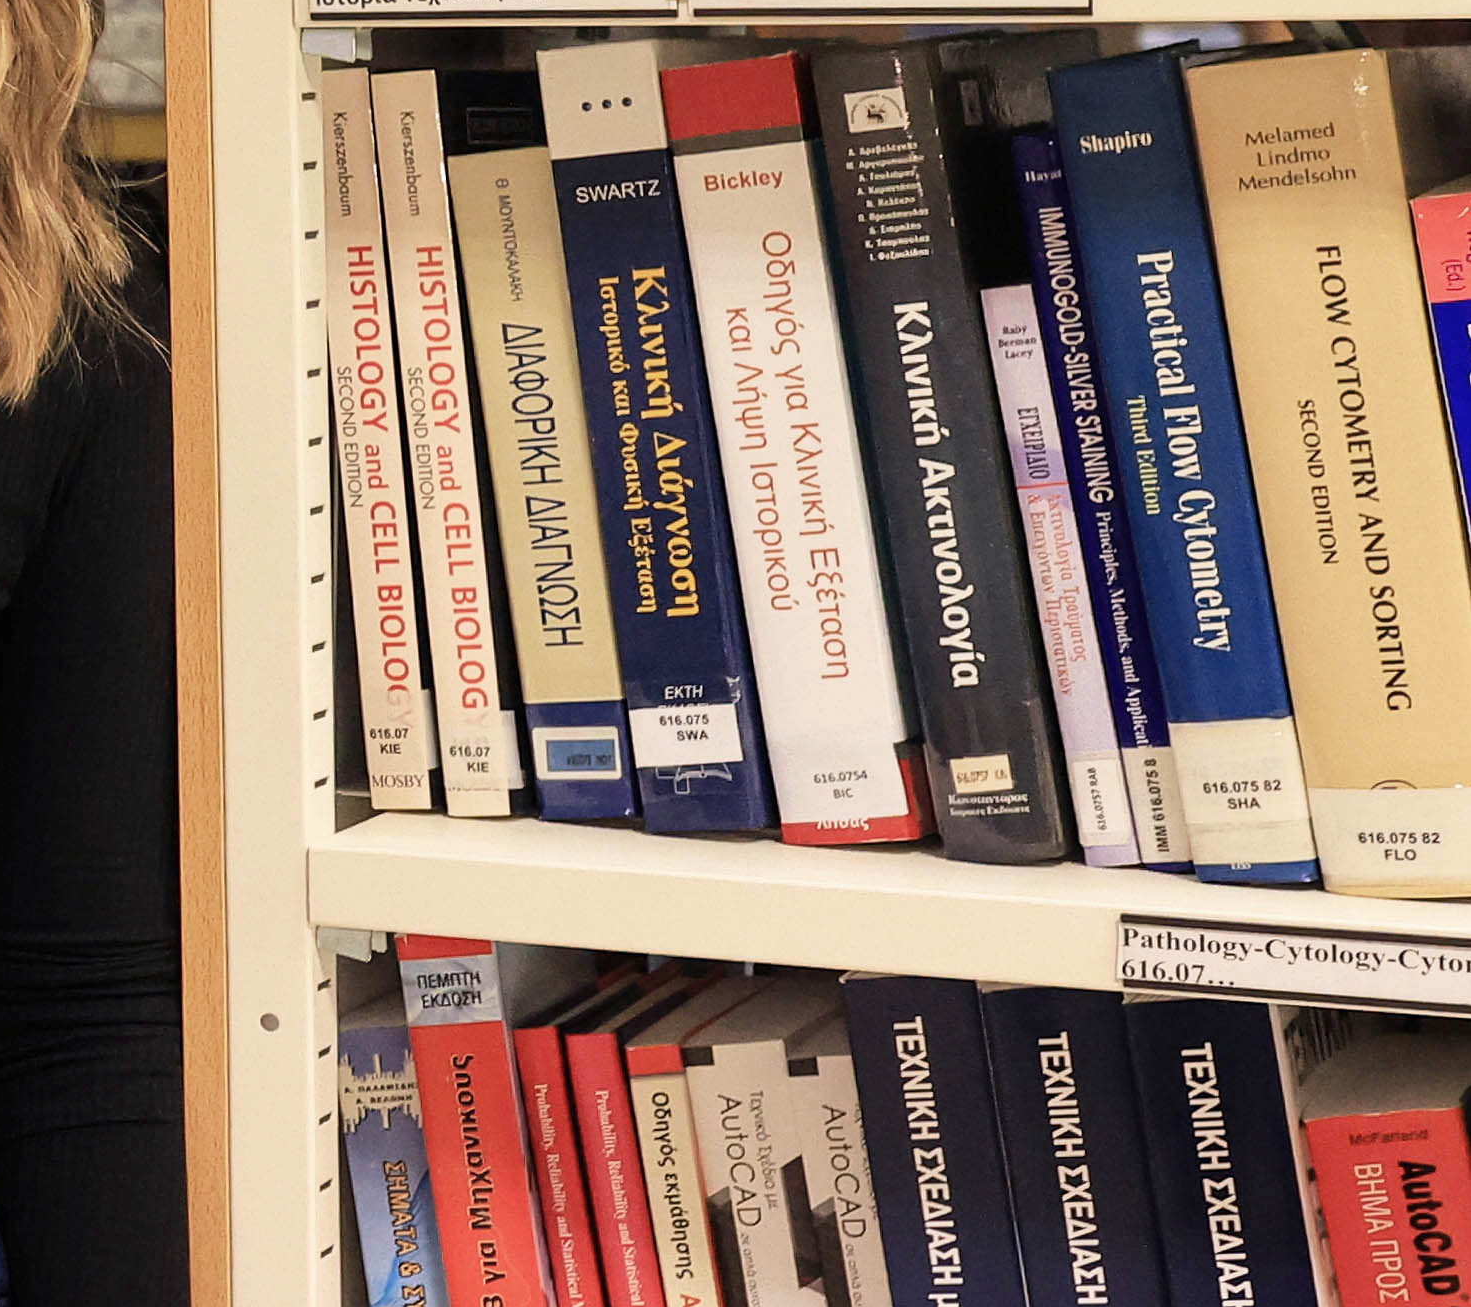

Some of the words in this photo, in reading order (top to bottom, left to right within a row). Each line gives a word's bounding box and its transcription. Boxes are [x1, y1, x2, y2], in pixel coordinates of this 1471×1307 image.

[333, 112, 352, 217] Kierszenbaum
[401, 111, 419, 217] Kierszenbaum
[1080, 130, 1152, 155] Shapiro
[1245, 123, 1335, 147] Melamed
[1256, 145, 1330, 168] Lindmo
[575, 179, 661, 204] SWARTZ
[703, 170, 783, 193] Bickley
[1238, 166, 1357, 191] Mendelsohn
[762, 230, 804, 355] Οδηγός
[1316, 245, 1351, 327] FLOW
[347, 245, 388, 432] HISTOLOGY
[416, 245, 460, 433] HISTOLOGY
[632, 266, 683, 419] Κλινική
[1136, 250, 1187, 396] Practical
[501, 323, 563, 485] ΔΙΑΦΟΡΙΚΗ
[775, 364, 808, 412] για
[892, 300, 951, 448] Κλινική
[1163, 402, 1202, 481] Flow
[1330, 336, 1381, 503] CYTOMETRY
[365, 443, 388, 490] and
[437, 445, 462, 491] and
[792, 420, 831, 537] Κλινική
[1298, 399, 1325, 479] SECOND
[1312, 485, 1339, 564] EDITION
[370, 501, 399, 574] CELL
[443, 503, 473, 576] CELL
[653, 431, 700, 618] Διάγνωση
[1359, 513, 1390, 576] AND
[525, 495, 584, 648] ΔΙΑΓΝΩΣΗ
[919, 457, 985, 689] Ακτινολογία
[1172, 488, 1233, 653] Cytometry
[806, 547, 851, 681] Εξέταση
[1369, 586, 1413, 713] SORTING
[370, 727, 409, 739] 616.07
[380, 743, 401, 755] KIE
[449, 745, 490, 757] 616.07
[659, 714, 710, 727] 616.075
[677, 730, 709, 741] SWA
[372, 774, 425, 788] MOSBY
[467, 761, 489, 773] KIE
[1228, 797, 1260, 809] SHA
[1384, 849, 1416, 861] FLO
[417, 972, 481, 989] ΠΕΜΠΤΗ
[421, 991, 482, 1010] ΕΚΔΟΣΗ
[893, 1015, 940, 1141] ΤΕΧΝΙΚΗ
[1038, 1031, 1085, 1158] ΤΕΧΝΙΚΗ
[1181, 1042, 1231, 1170] ΤΕΧΝΙΚΗ
[452, 1053, 495, 1230] Μηχανικούς
[533, 1083, 554, 1150] Probability,
[546, 1153, 566, 1213] Reliability
[717, 1093, 761, 1228] AutoCAD
[822, 1104, 866, 1238] AutoCAD
[556, 1216, 572, 1236] and
[913, 1146, 963, 1285] ΣΧΕΔΙΑΣΗ
[1056, 1164, 1108, 1305] ΣΧΕΔΙΑΣΗ
[1353, 1162, 1392, 1234] ΒΗΜΑ
[1398, 1160, 1463, 1295] AutoCAD
[479, 1241, 506, 1284] για
[559, 1239, 581, 1298] Statistical
[1369, 1238, 1410, 1303] ΠΡΟΣ
